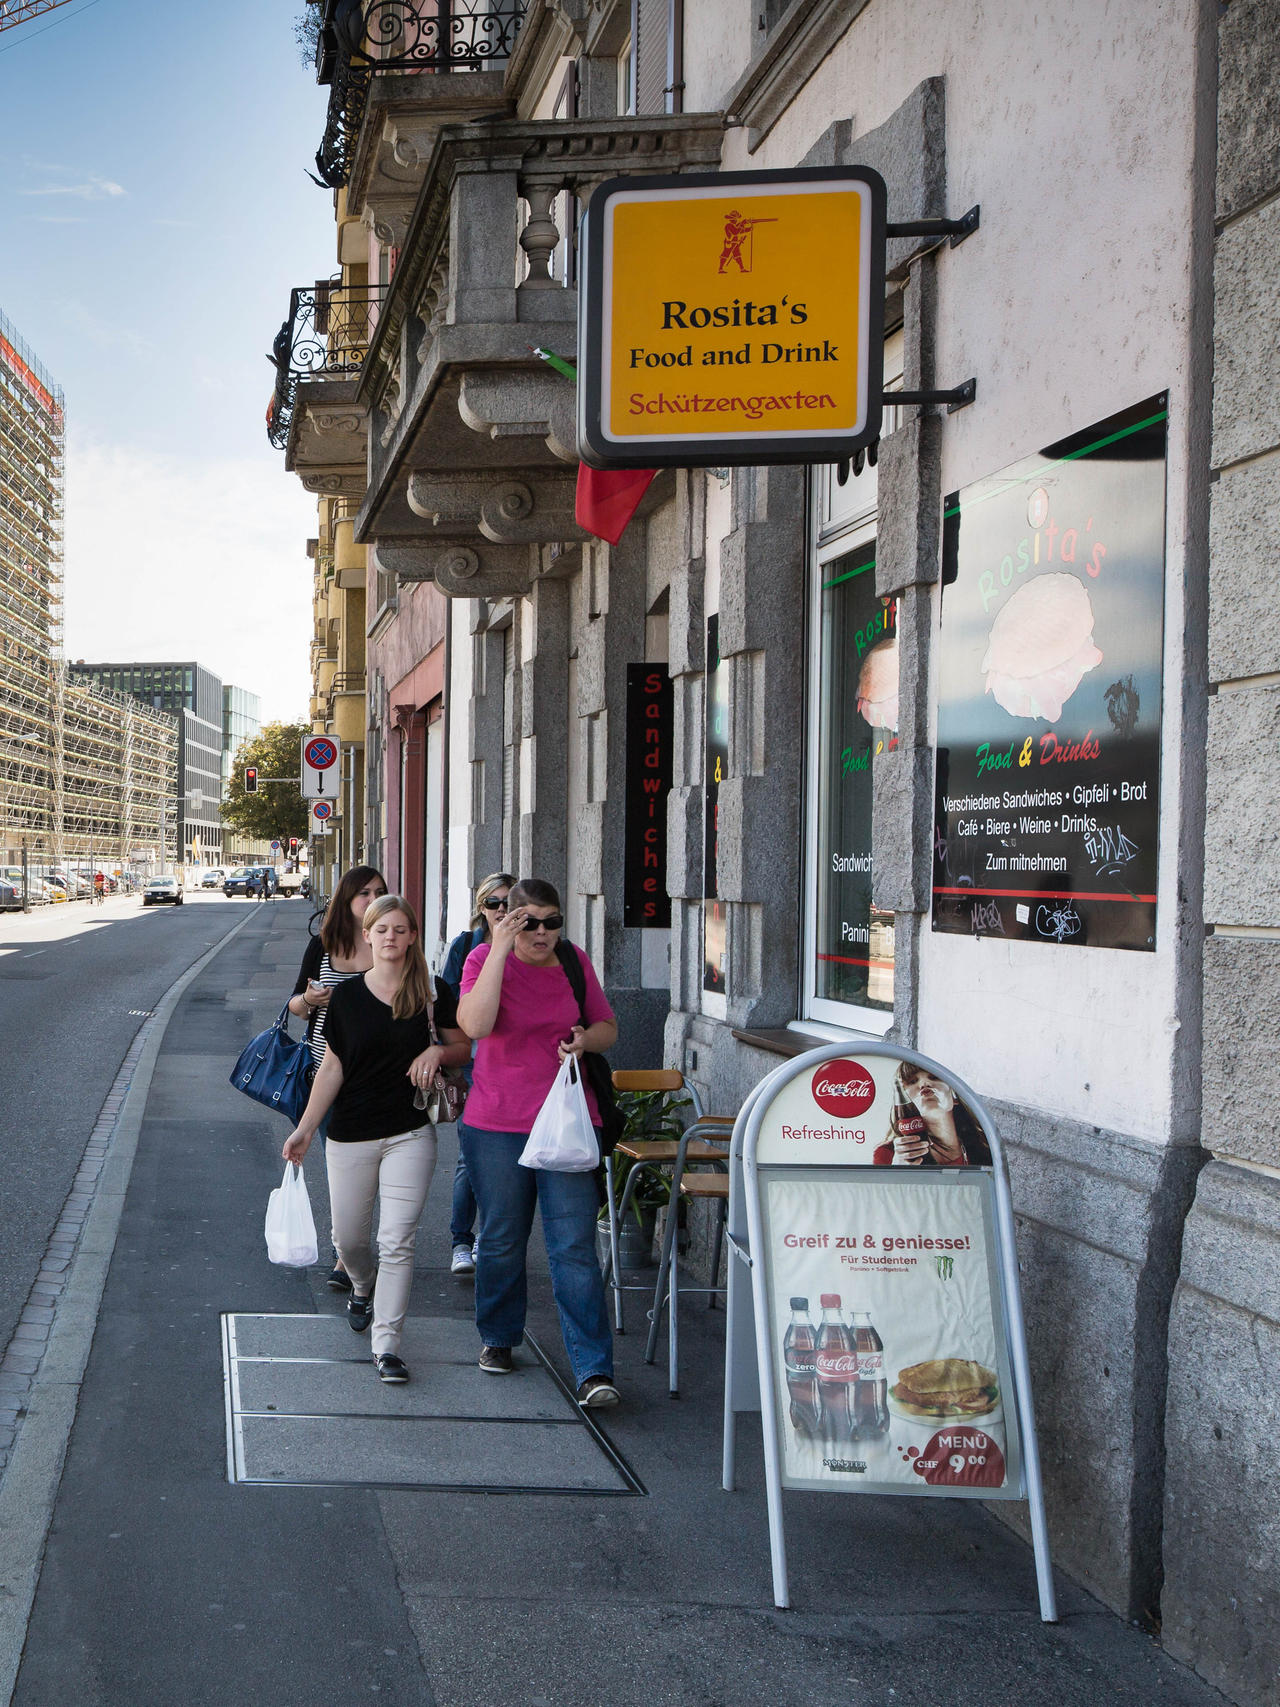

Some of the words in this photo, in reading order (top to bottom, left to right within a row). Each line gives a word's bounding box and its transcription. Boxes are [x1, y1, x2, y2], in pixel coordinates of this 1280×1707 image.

[629, 346, 693, 368] Food
[702, 343, 751, 365] and
[761, 340, 839, 364] Drink
[629, 390, 837, 419] Schützengarten
[840, 745, 871, 779] Food
[975, 742, 1015, 778] Food
[1018, 735, 1033, 768] &
[1039, 729, 1101, 765] Drinks
[643, 673, 663, 917] Sandwiches
[942, 794, 1001, 813] Verschiedene
[1002, 788, 1063, 809] Sandwiches
[1073, 783, 1110, 808] Gipfeli
[1121, 781, 1148, 801] Brot
[957, 818, 979, 836] Café
[986, 817, 1011, 836] Biere
[1020, 815, 1052, 835] Weine
[1061, 813, 1107, 833] Drinks...
[985, 853, 1008, 871] Zum
[1009, 853, 1067, 872] mitnehmen
[841, 922, 869, 944] Panini
[781, 1125, 866, 1144] Refreshing
[783, 1234, 830, 1249] Greif
[835, 1236, 857, 1249] zu
[862, 1234, 876, 1249] &
[882, 1235, 971, 1252] geniesse!
[840, 1255, 859, 1264] Für
[861, 1256, 918, 1265] Studenten
[796, 1363, 816, 1371] zero
[938, 1433, 988, 1449] MENÜ
[917, 1460, 939, 1469] CHF
